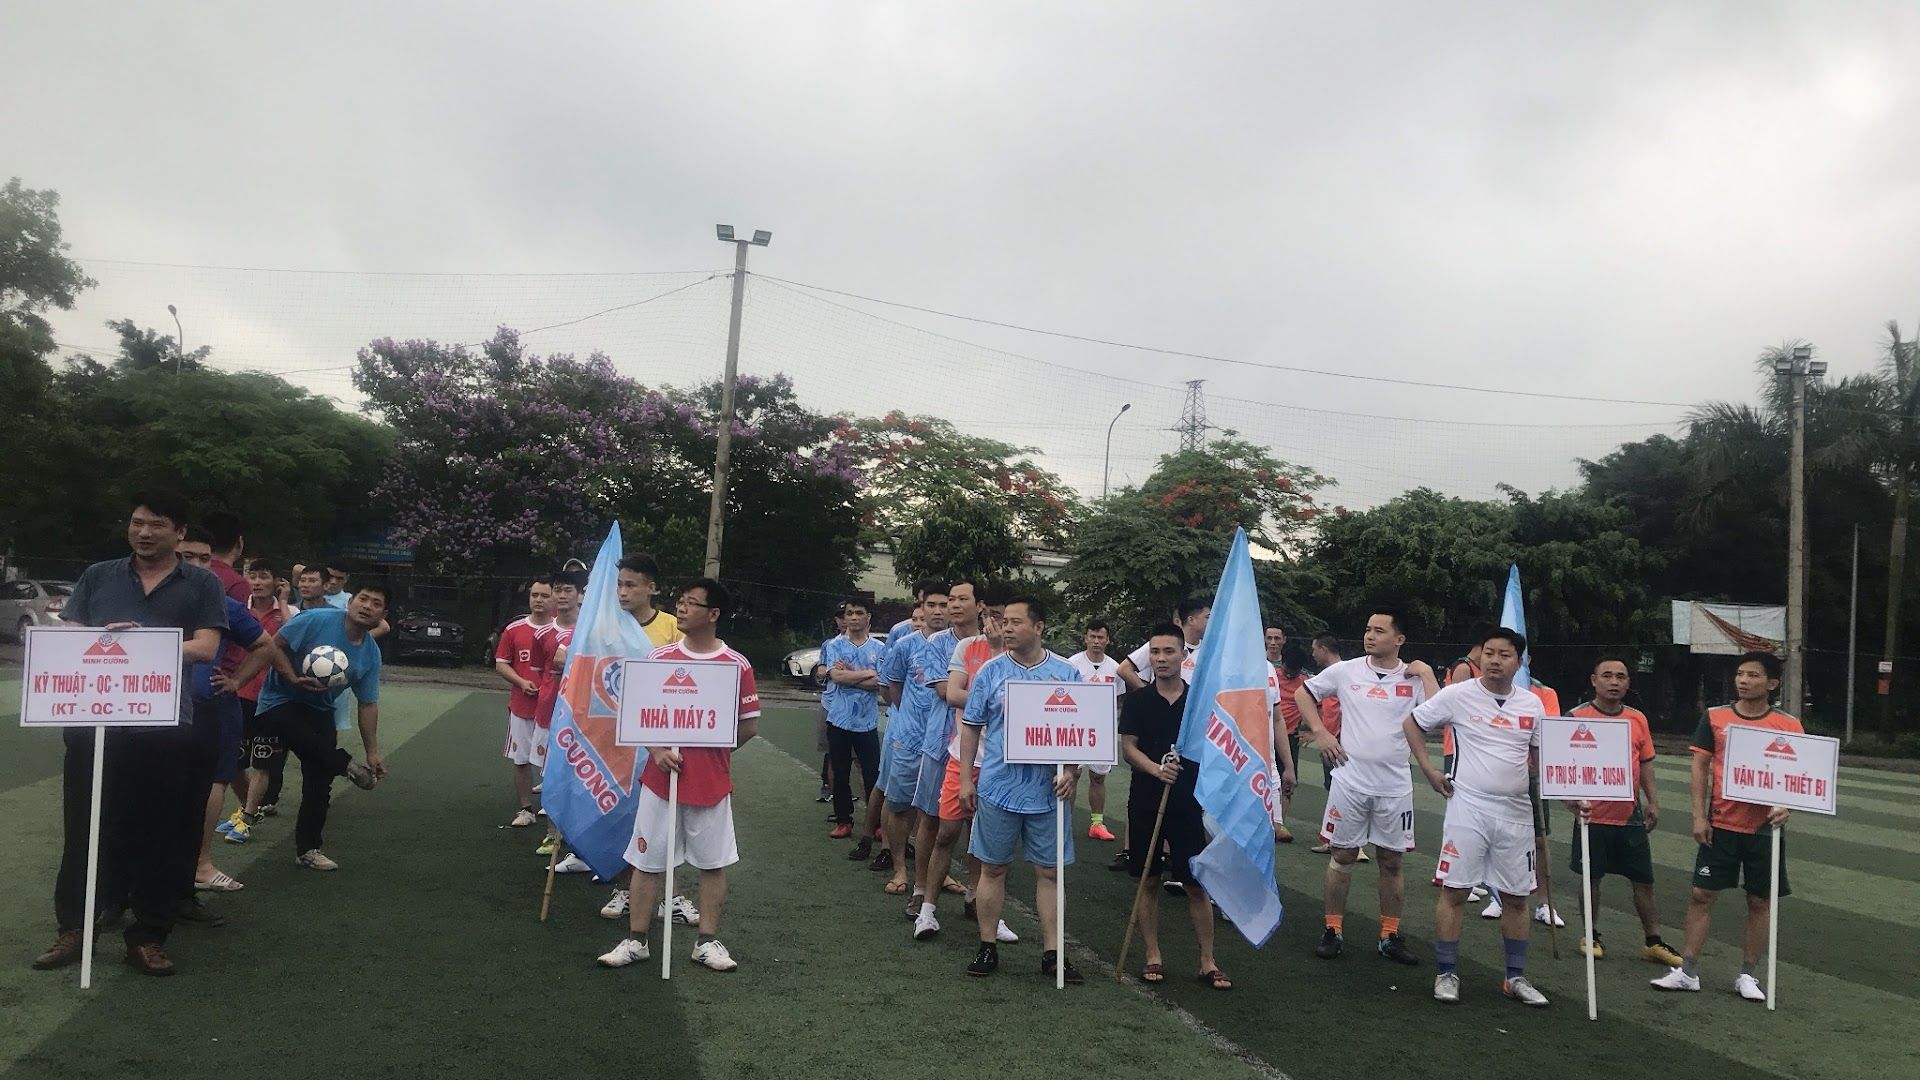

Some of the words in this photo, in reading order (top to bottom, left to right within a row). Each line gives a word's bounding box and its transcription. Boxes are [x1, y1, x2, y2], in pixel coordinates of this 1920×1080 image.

[34, 671, 49, 694] KỸ
[52, 671, 87, 698] THUẬT
[96, 674, 112, 695] QC
[122, 674, 139, 694] THI
[142, 670, 172, 694] CÔNG
[51, 702, 77, 717] (KT
[91, 702, 113, 715] QC
[128, 702, 152, 717] TC)
[640, 704, 669, 729] NHÀ
[673, 704, 704, 729] MÁY
[707, 709, 716, 730] 3
[1025, 723, 1053, 747] NHÀ
[1056, 723, 1085, 747] MÁY
[1088, 728, 1096, 747] 5
[1545, 765, 1554, 785] VP
[1582, 766, 1597, 785] NM2
[1602, 767, 1626, 786] DUSAN
[1733, 764, 1754, 790] VẬN
[1758, 764, 1774, 790] TẢI
[1784, 771, 1813, 796] THIẾT
[1815, 778, 1827, 801] BỊ
[1401, 810, 1413, 831] 17
